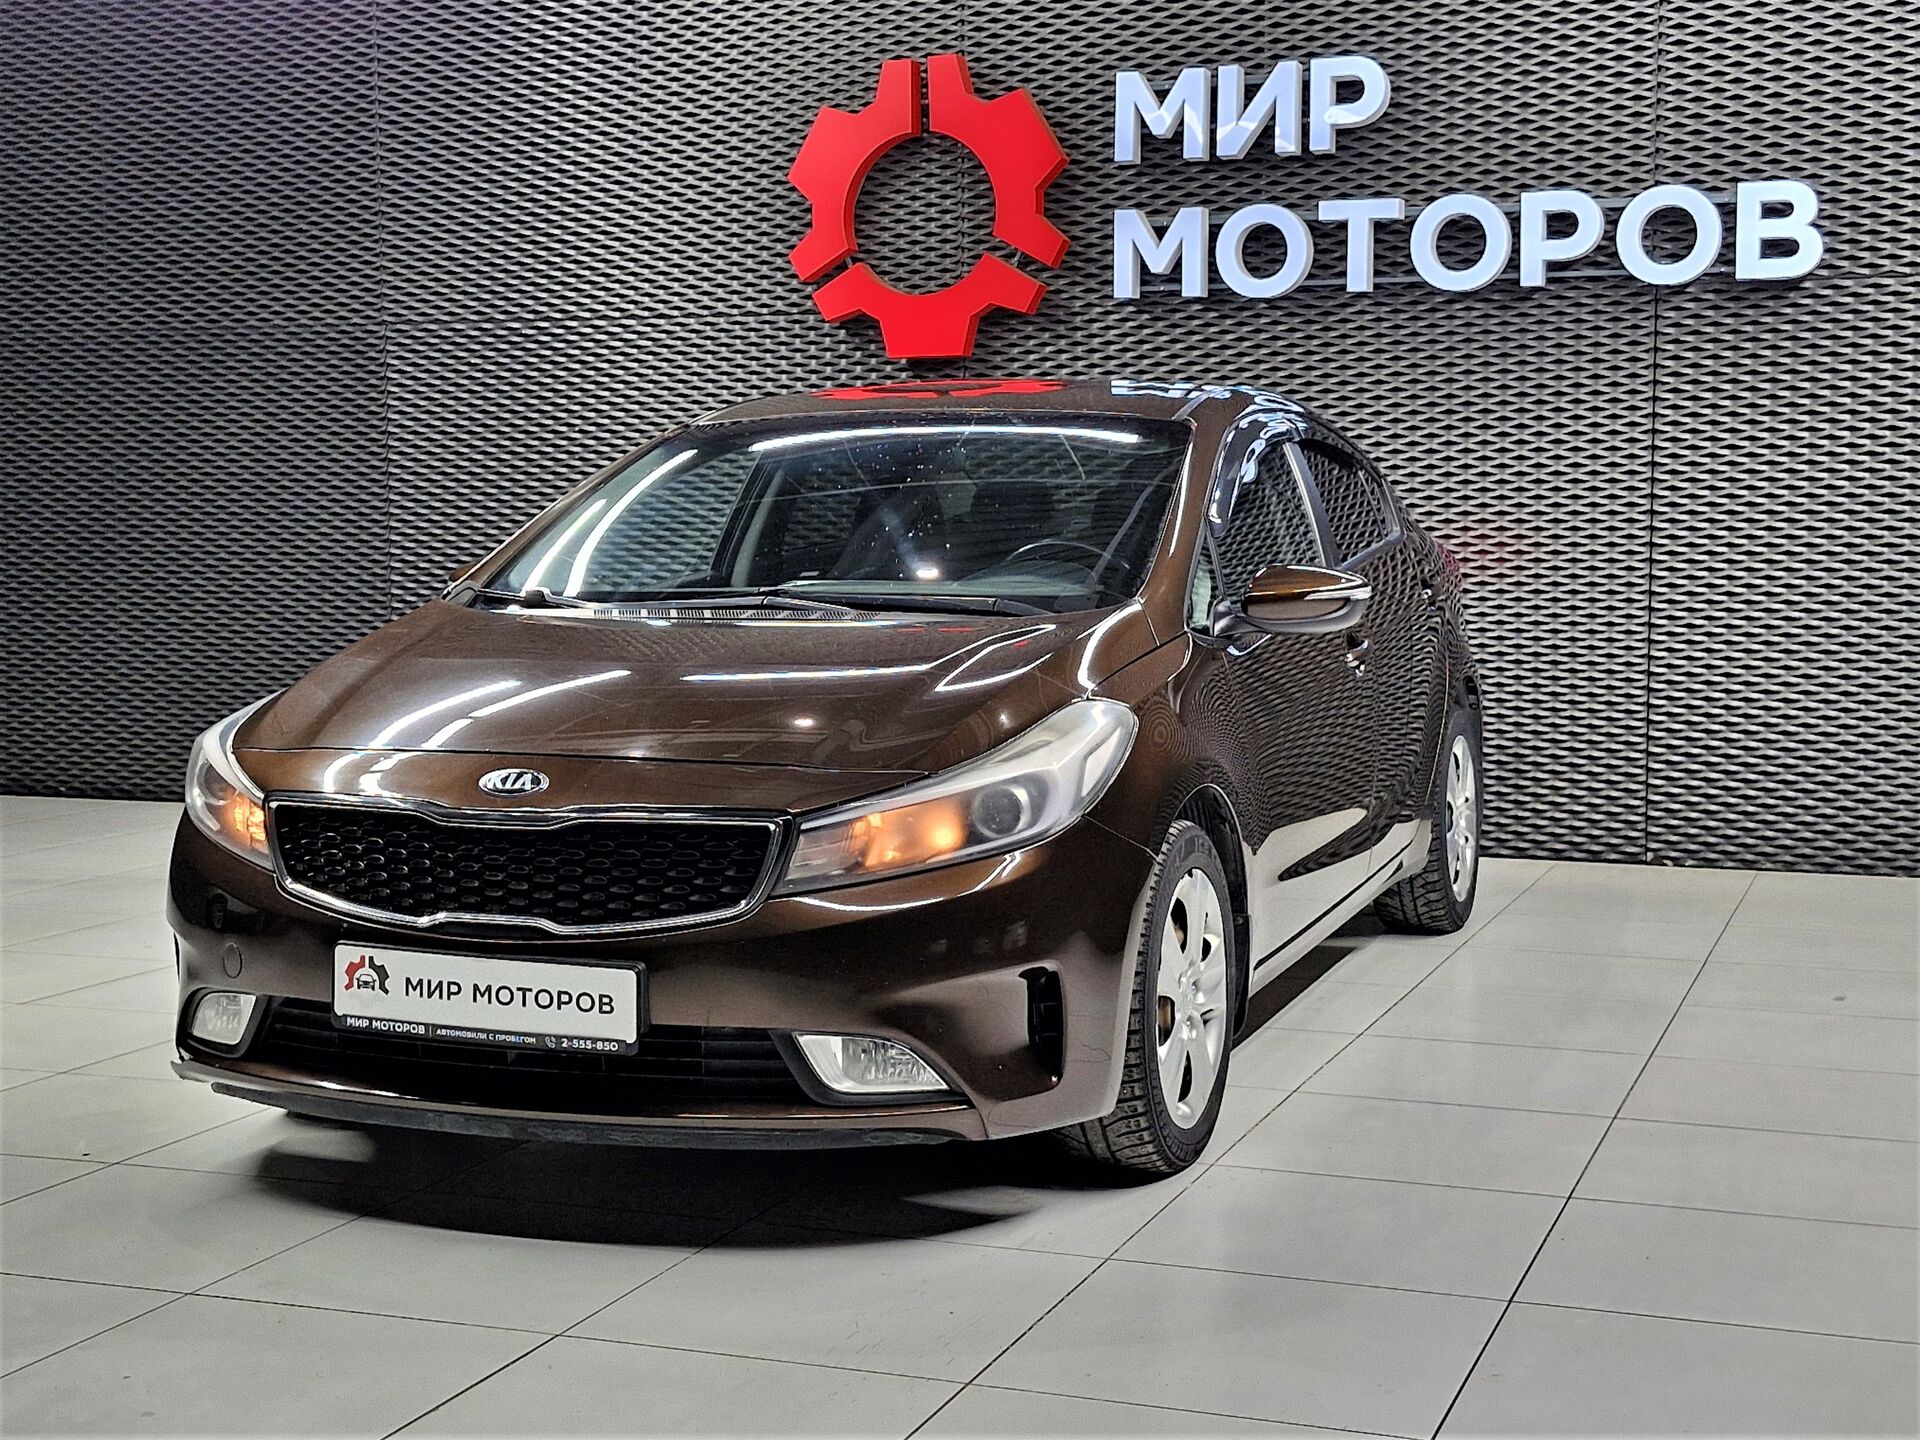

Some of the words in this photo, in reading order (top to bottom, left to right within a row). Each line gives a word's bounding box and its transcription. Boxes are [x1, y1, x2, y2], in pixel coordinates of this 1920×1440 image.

[1113, 55, 1391, 164] МИР
[1113, 180, 1825, 300] МОТОРОВ
[486, 772, 533, 791] KIA
[404, 976, 462, 1001] МИР
[472, 982, 616, 1015] МОТОРОВ
[346, 1016, 369, 1028] МИР
[372, 1019, 426, 1035] МОТОРОВ
[435, 1028, 487, 1040] АВТОМОБИЛИ
[561, 1038, 619, 1051] 2-555-850
